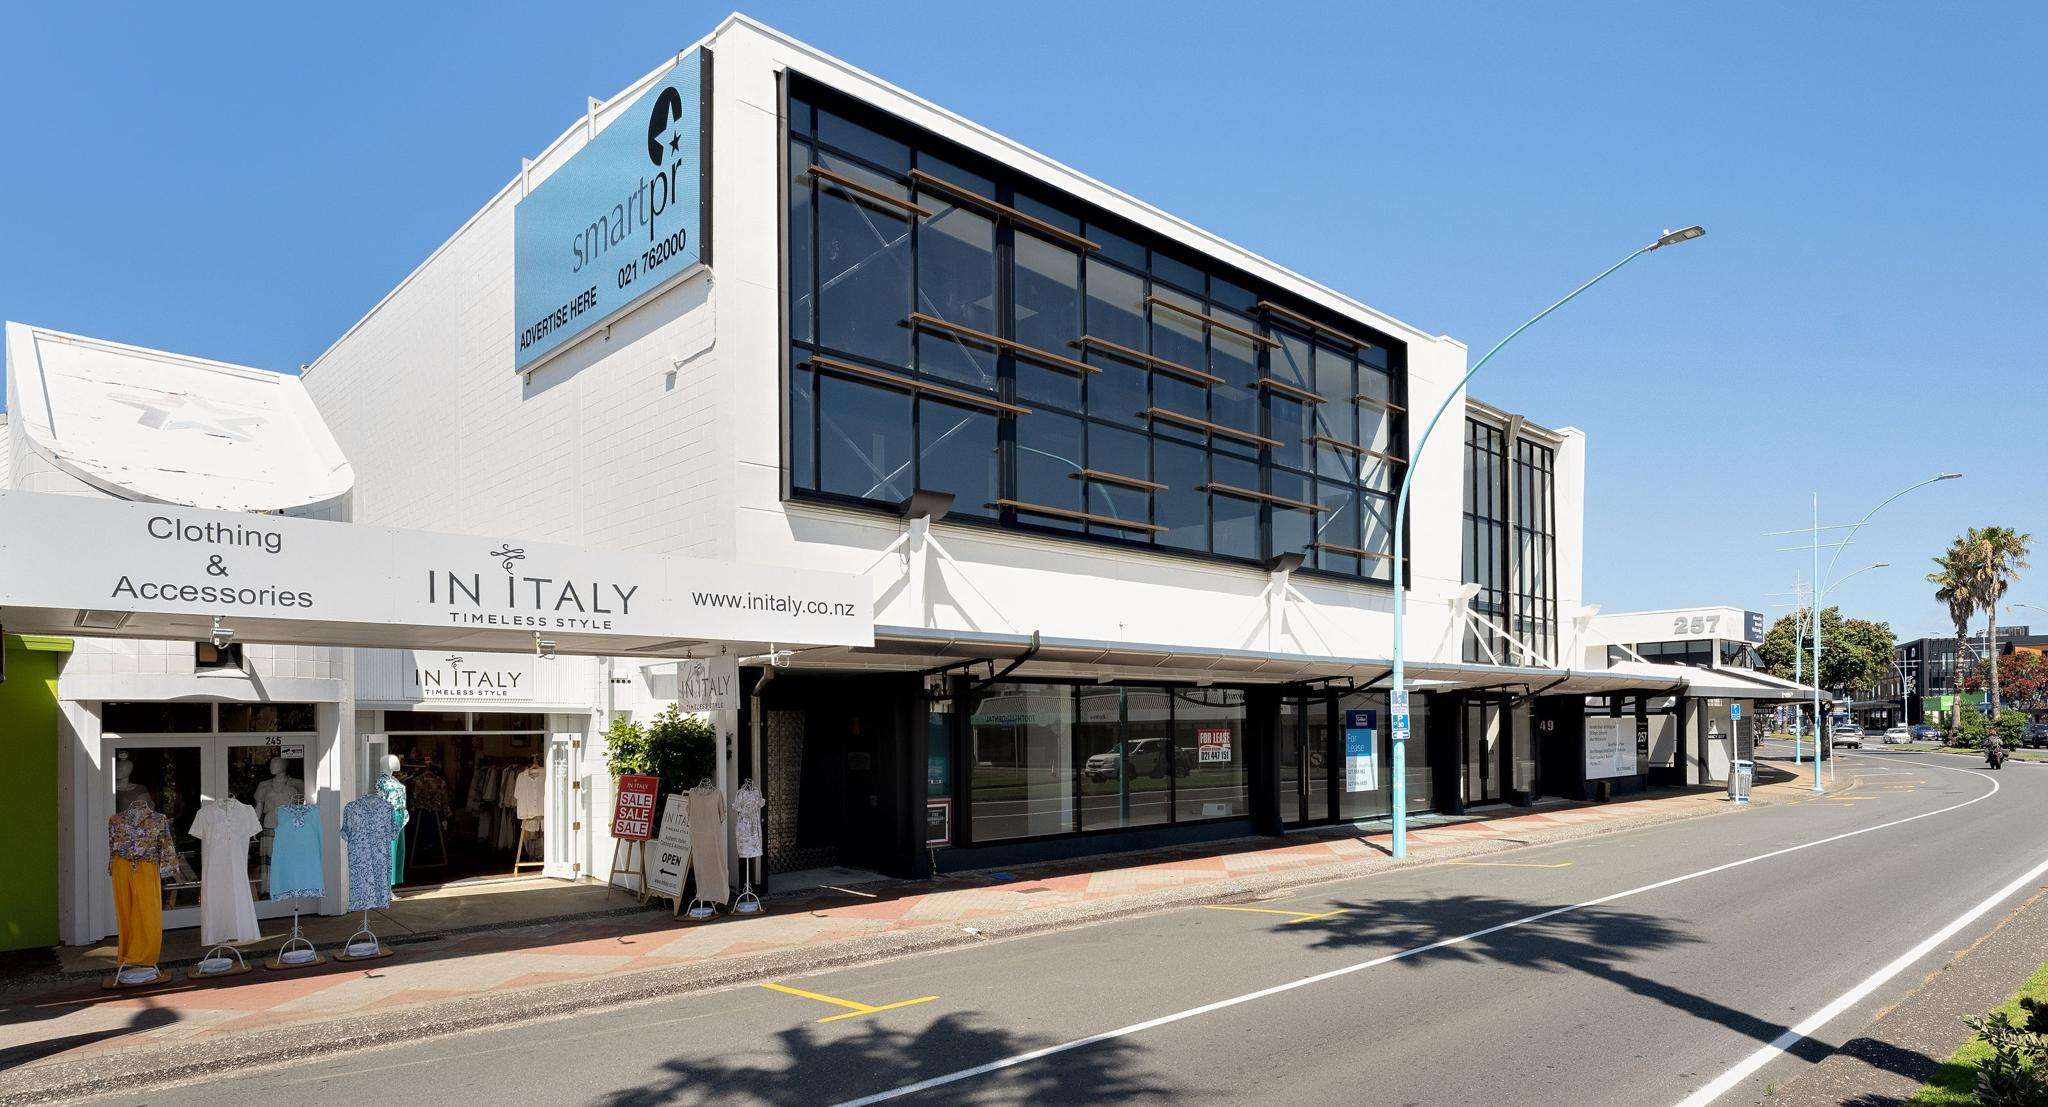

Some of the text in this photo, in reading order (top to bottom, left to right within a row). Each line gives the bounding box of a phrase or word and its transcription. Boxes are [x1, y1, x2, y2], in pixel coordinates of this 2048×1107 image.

[572, 157, 682, 274] smartpr
[617, 228, 686, 290] 021 762000
[520, 285, 597, 352] ADVERTISE HERE
[147, 516, 282, 554] Clothing
[206, 554, 229, 577] &
[111, 575, 314, 609] Accessories
[429, 570, 639, 614] IN ITALY
[692, 591, 856, 618] www.initaly.co.nz
[449, 612, 612, 630] TIMELESS STYLE
[1674, 614, 1721, 635] 257
[415, 668, 522, 688] IN ITALY
[698, 674, 731, 698] ITALY
[265, 736, 282, 745] 245
[1200, 732, 1230, 744] FOR LEASE
[1637, 731, 1648, 743] 257
[1347, 744, 1365, 752] Lease
[621, 793, 652, 807] SALE
[619, 807, 650, 821] SALE
[616, 821, 648, 835] SALE
[661, 852, 682, 867] OPEN
